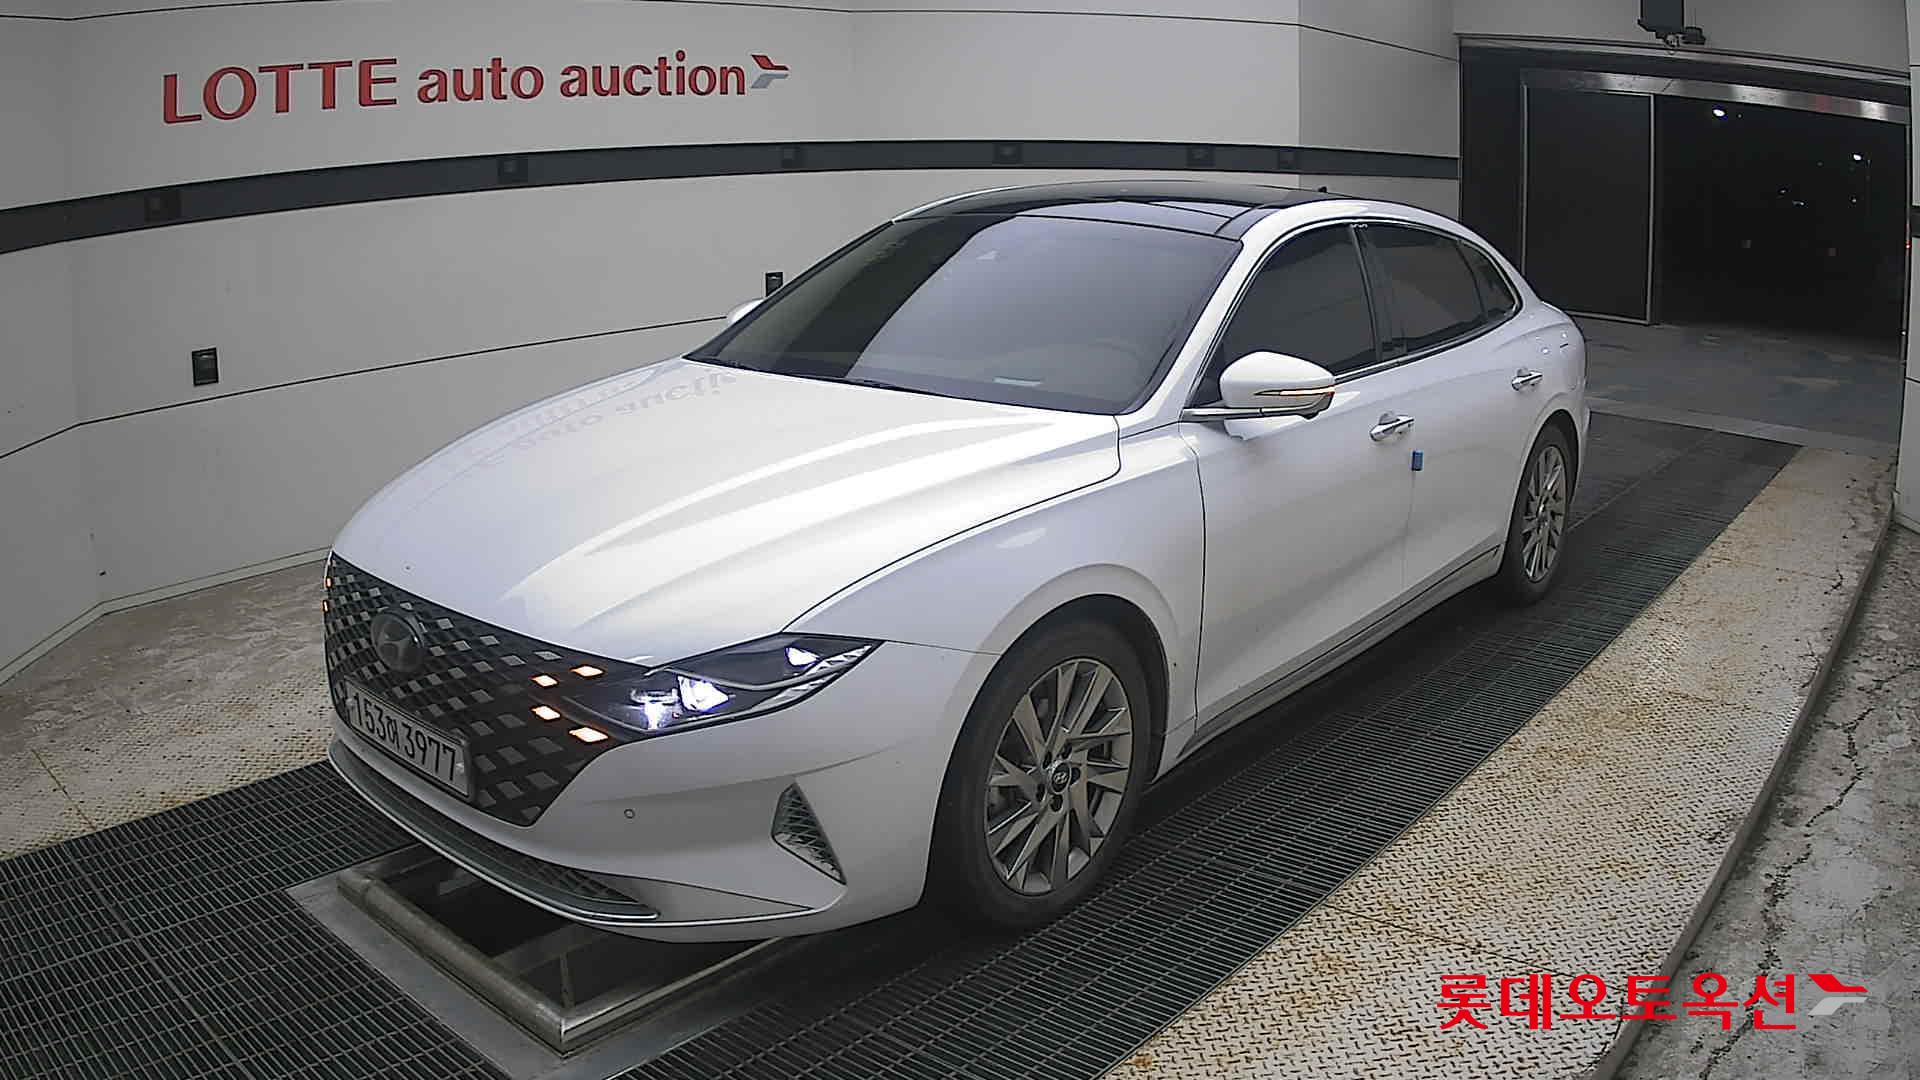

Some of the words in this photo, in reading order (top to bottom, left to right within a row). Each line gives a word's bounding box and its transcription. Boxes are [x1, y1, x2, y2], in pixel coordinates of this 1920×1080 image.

[163, 58, 397, 124] LOTTE
[417, 57, 545, 103] auto
[559, 50, 747, 98] auction
[401, 722, 456, 781] 3977
